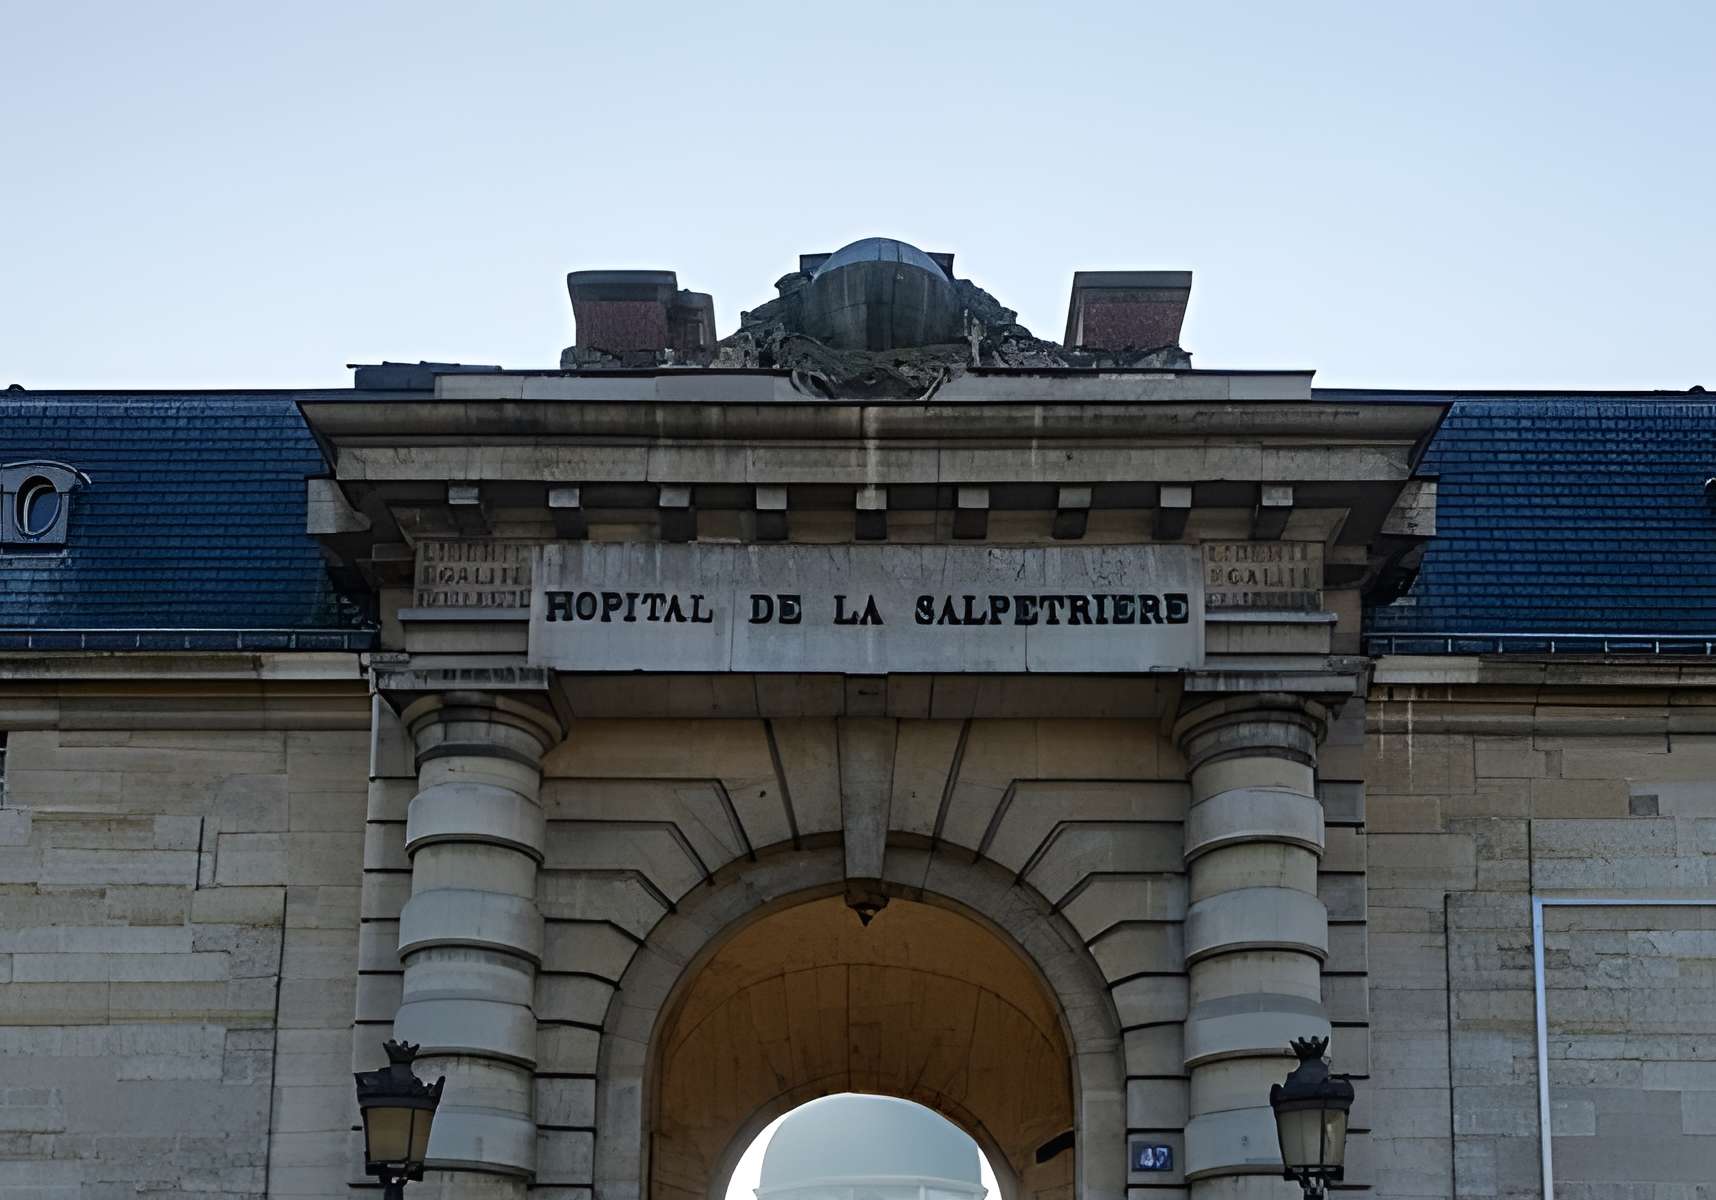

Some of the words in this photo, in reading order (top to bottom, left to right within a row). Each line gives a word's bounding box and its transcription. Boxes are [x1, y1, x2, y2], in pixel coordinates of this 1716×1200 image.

[544, 591, 713, 624] HOPITAL
[748, 592, 801, 624] DE
[833, 593, 884, 625] LA
[914, 593, 1189, 626] SALPETRIERE
